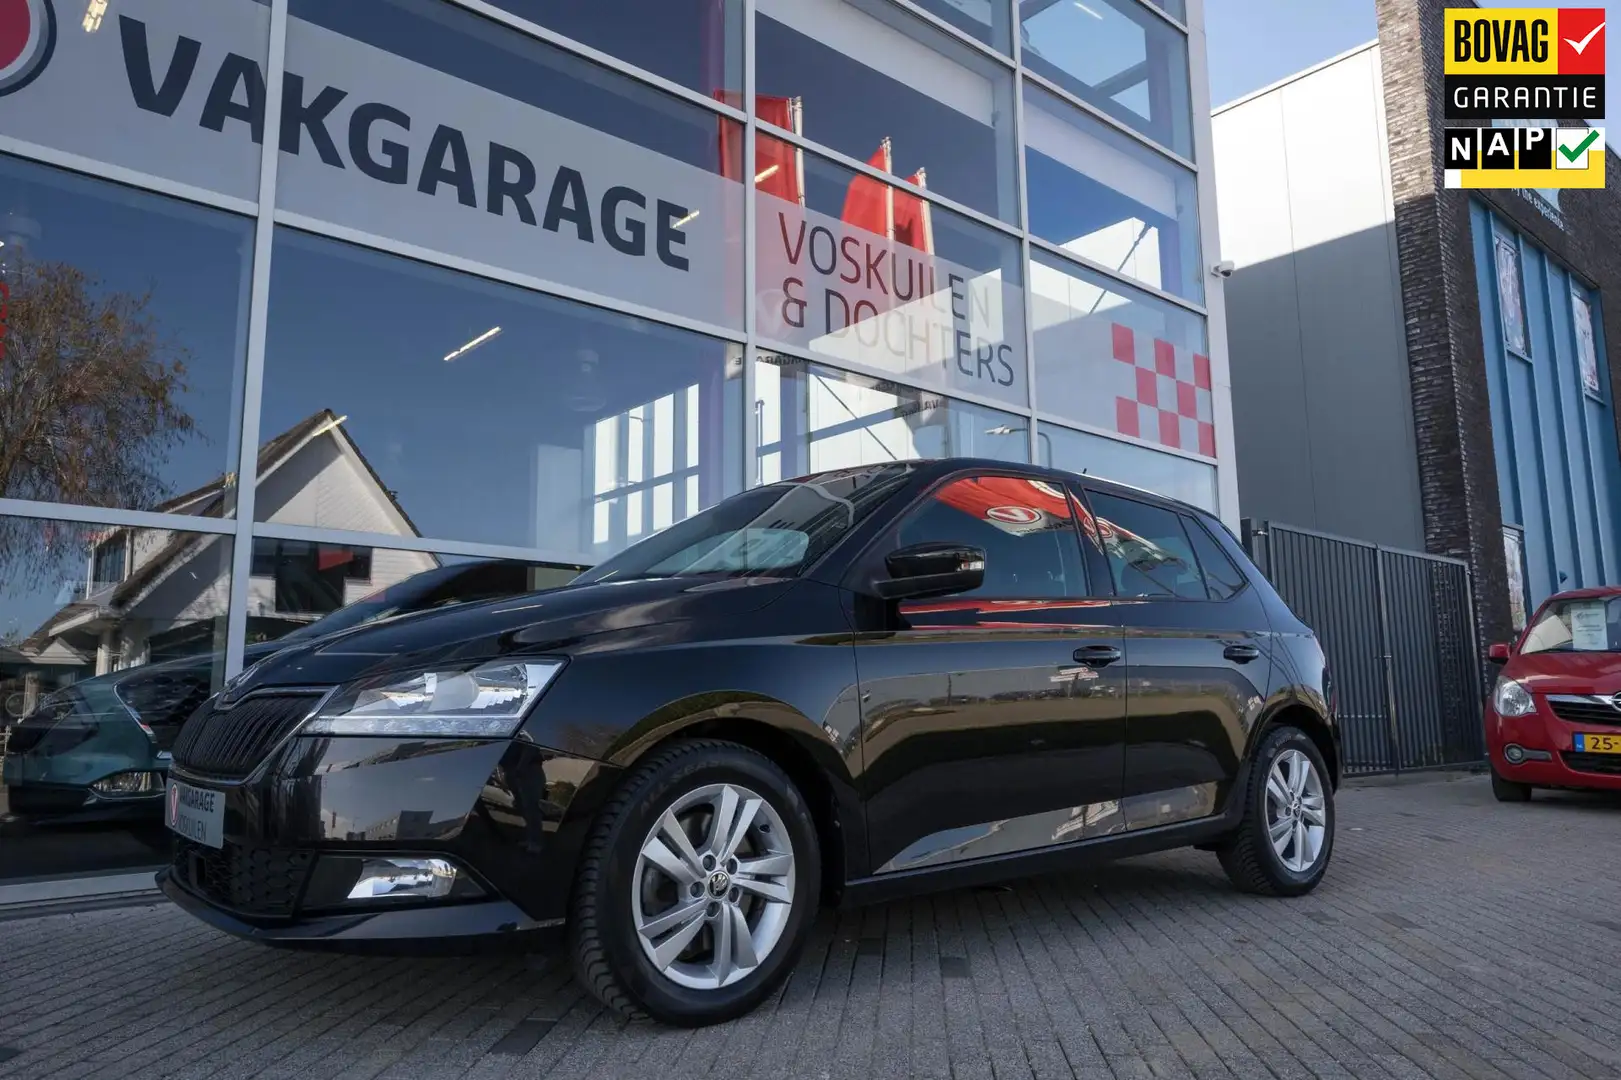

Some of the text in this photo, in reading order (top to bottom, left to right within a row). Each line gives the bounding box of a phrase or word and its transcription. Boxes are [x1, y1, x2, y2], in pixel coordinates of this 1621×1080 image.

[118, 14, 690, 272] VAKGARAGE
[778, 211, 991, 330] VOSKUILEN
[782, 277, 1015, 387] & DOCHTERS
